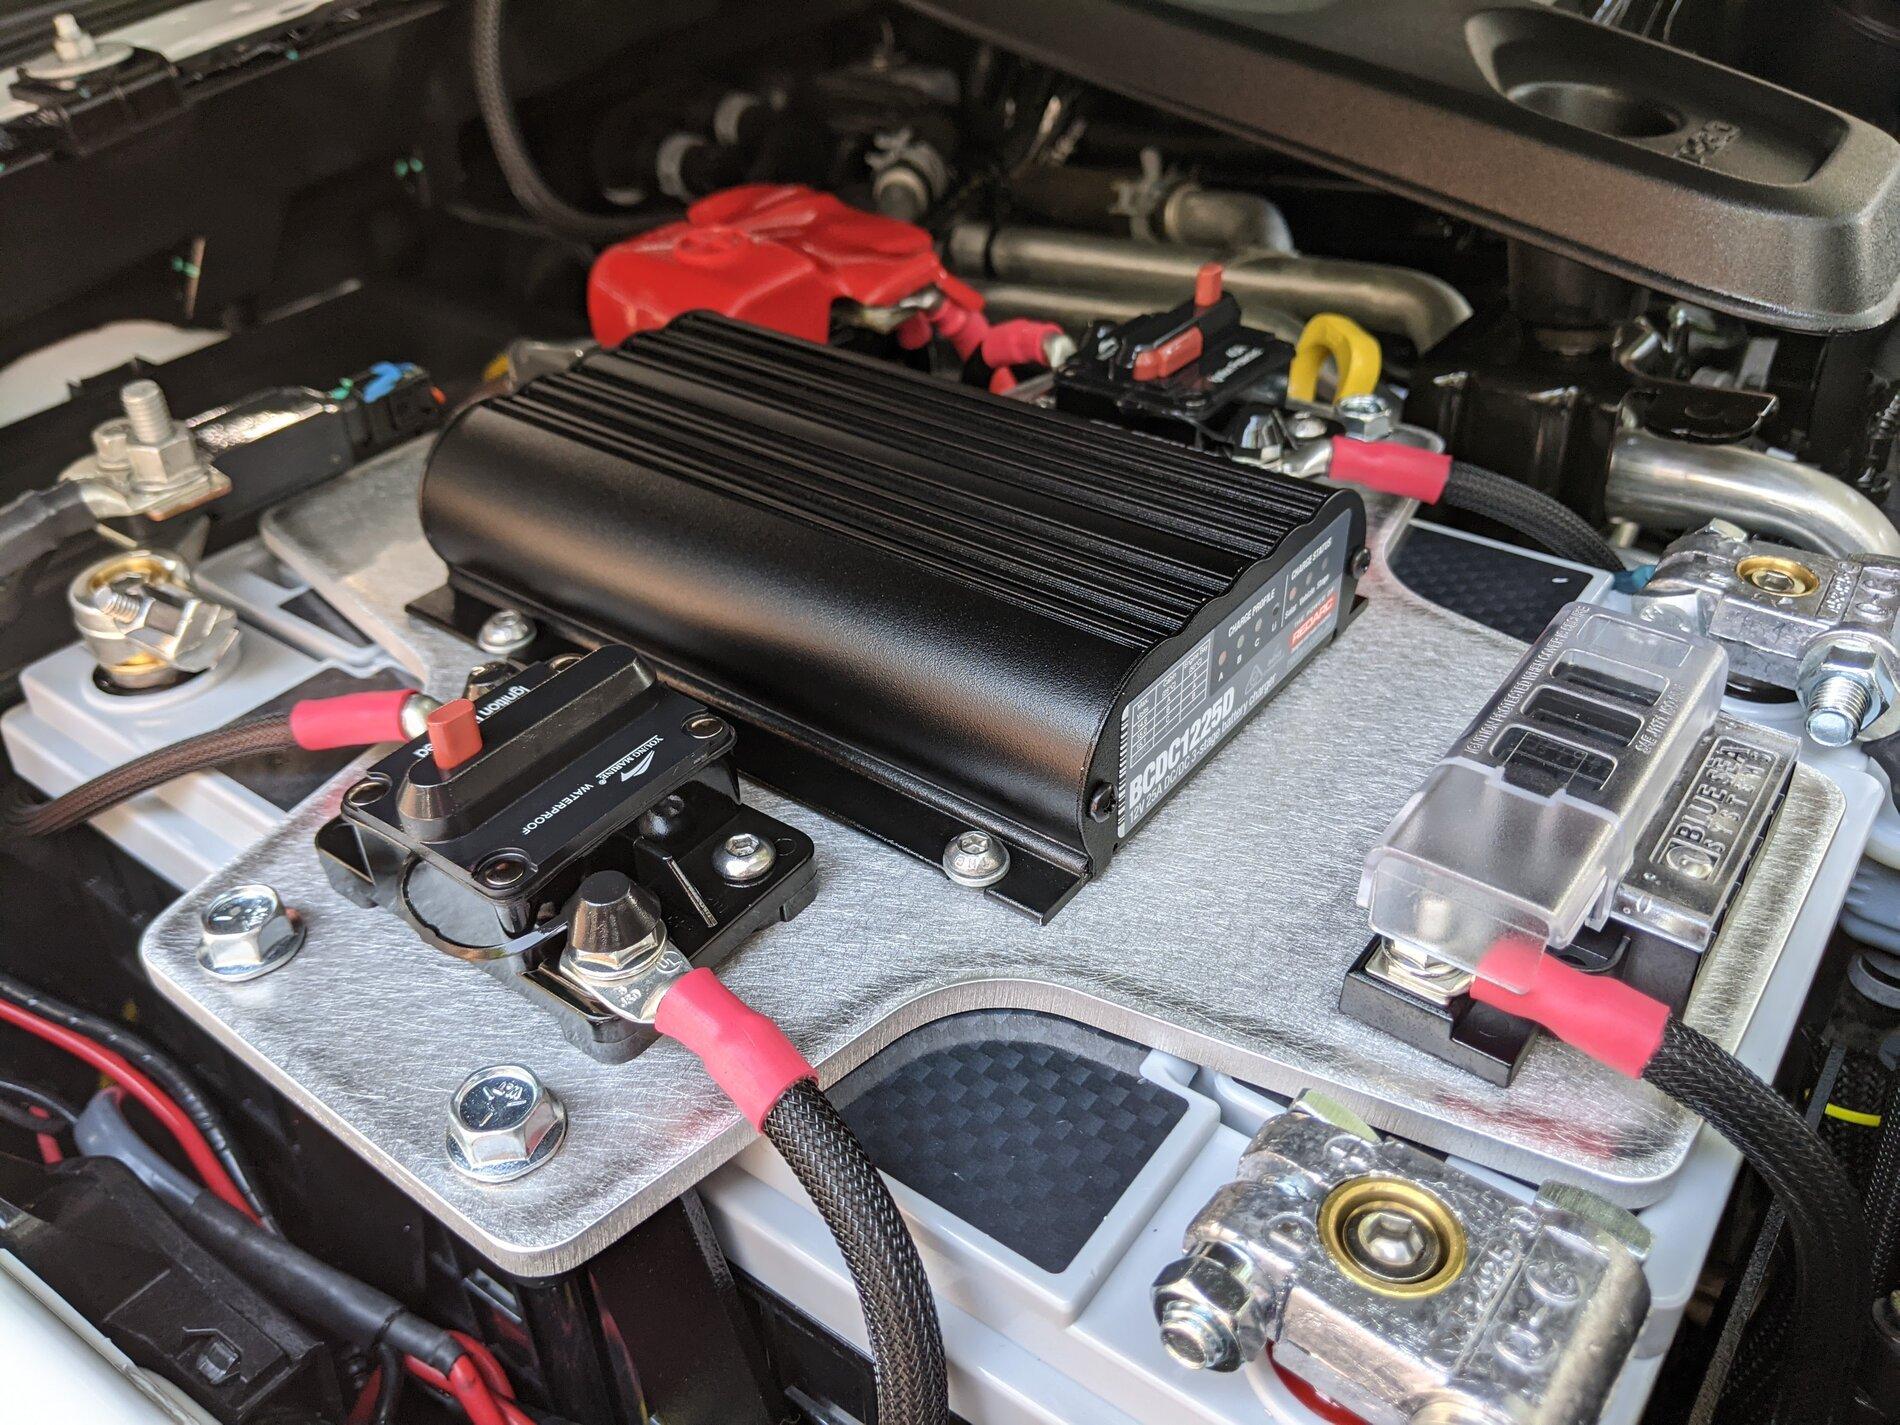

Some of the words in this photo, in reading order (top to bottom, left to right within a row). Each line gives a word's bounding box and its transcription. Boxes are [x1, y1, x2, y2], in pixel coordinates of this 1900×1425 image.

[1291, 554, 1312, 580] CHARGE
[1228, 610, 1251, 638] CHARGE
[1251, 588, 1276, 618] PROFILE
[1291, 597, 1335, 645] REDARC
[1236, 653, 1242, 665] B
[1254, 636, 1260, 647] C
[1217, 672, 1224, 682] A
[480, 685, 531, 717] Ignition
[633, 737, 664, 759] YOUNG
[1129, 686, 1235, 810] BCDC1225D
[1129, 800, 1144, 824] 12V
[1146, 785, 1163, 808] 25A
[1163, 757, 1191, 791] DC/DC
[1221, 700, 1249, 733] battery
[1248, 672, 1277, 706] charger
[522, 782, 595, 836] WATERPROOF
[1673, 783, 1727, 842] BLUE
[1705, 745, 1751, 785] SEA
